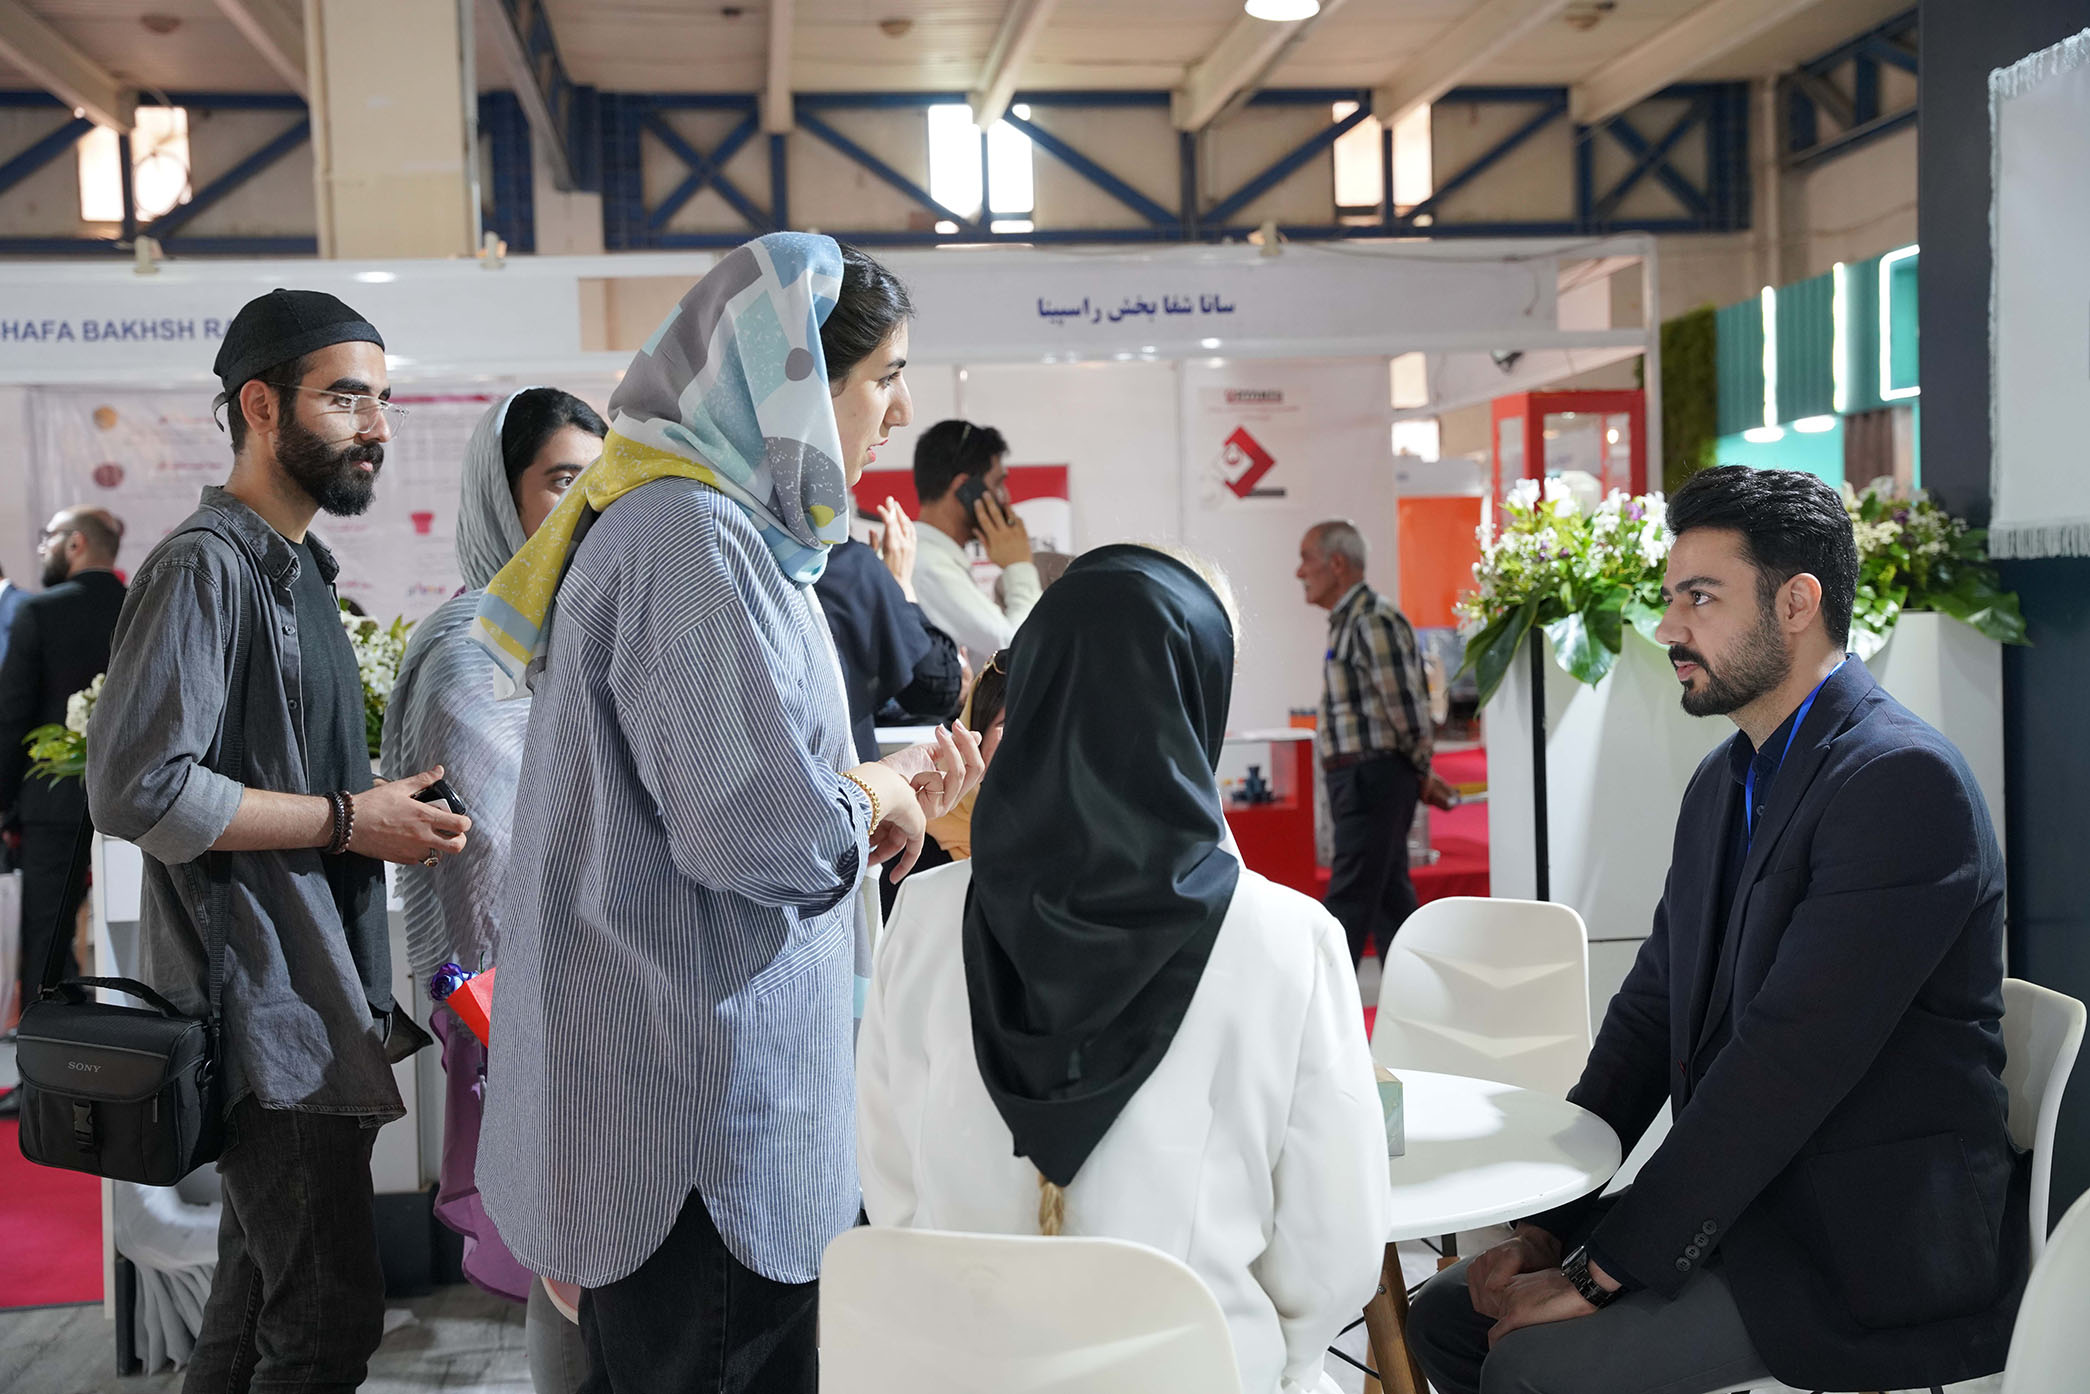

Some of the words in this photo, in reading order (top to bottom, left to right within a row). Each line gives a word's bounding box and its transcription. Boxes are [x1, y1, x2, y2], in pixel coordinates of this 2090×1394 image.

[1107, 296, 1157, 322] بخش
[1163, 295, 1193, 314] شفا
[1199, 294, 1235, 314] سانا
[82, 318, 196, 341] BAKHSH
[67, 1060, 102, 1073] SONY
